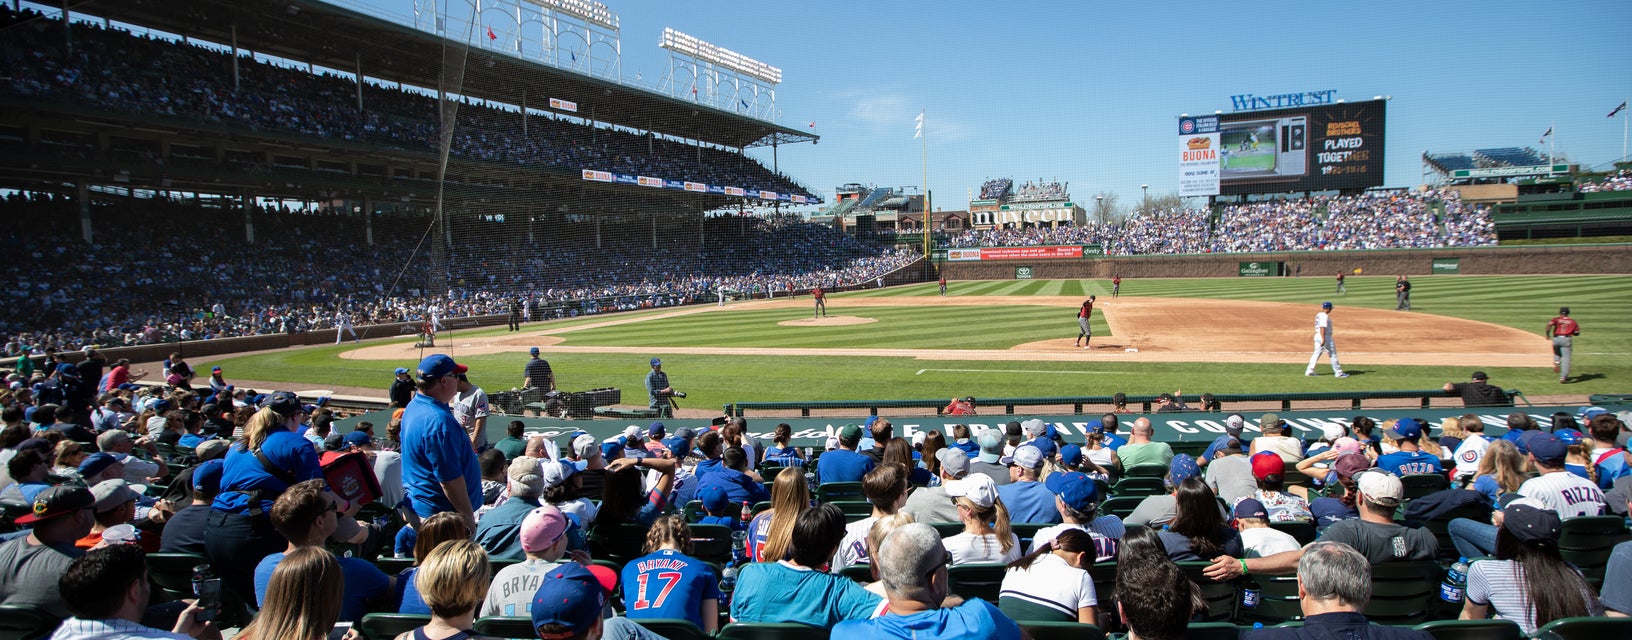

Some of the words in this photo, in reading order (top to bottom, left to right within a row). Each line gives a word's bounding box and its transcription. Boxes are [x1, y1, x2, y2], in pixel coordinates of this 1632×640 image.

[1324, 137, 1363, 150] PLAYED
[1182, 149, 1217, 161] BUONA
[1561, 486, 1606, 506] RIZZO
[637, 558, 688, 573] BRYANT
[503, 575, 539, 598] BRYA
[634, 571, 682, 610] 17
